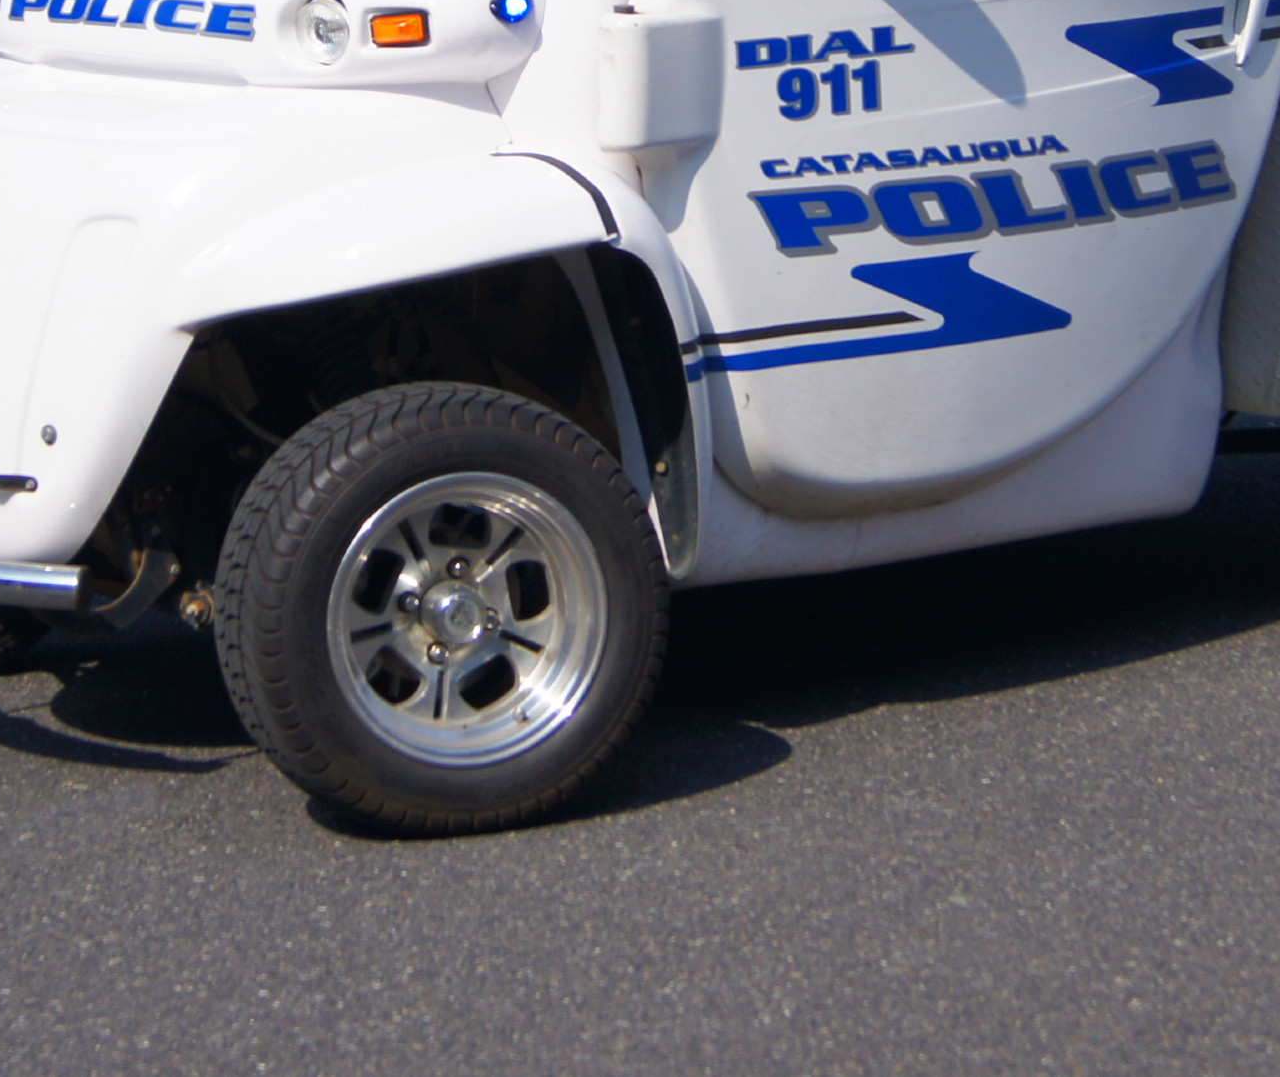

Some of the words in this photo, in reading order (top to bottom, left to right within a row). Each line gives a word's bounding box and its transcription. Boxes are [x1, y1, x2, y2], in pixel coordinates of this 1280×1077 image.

[734, 26, 914, 70] DIAL
[777, 61, 882, 120] 911
[760, 135, 1068, 179] CATASAUQUA
[747, 140, 1236, 256] POLICE
